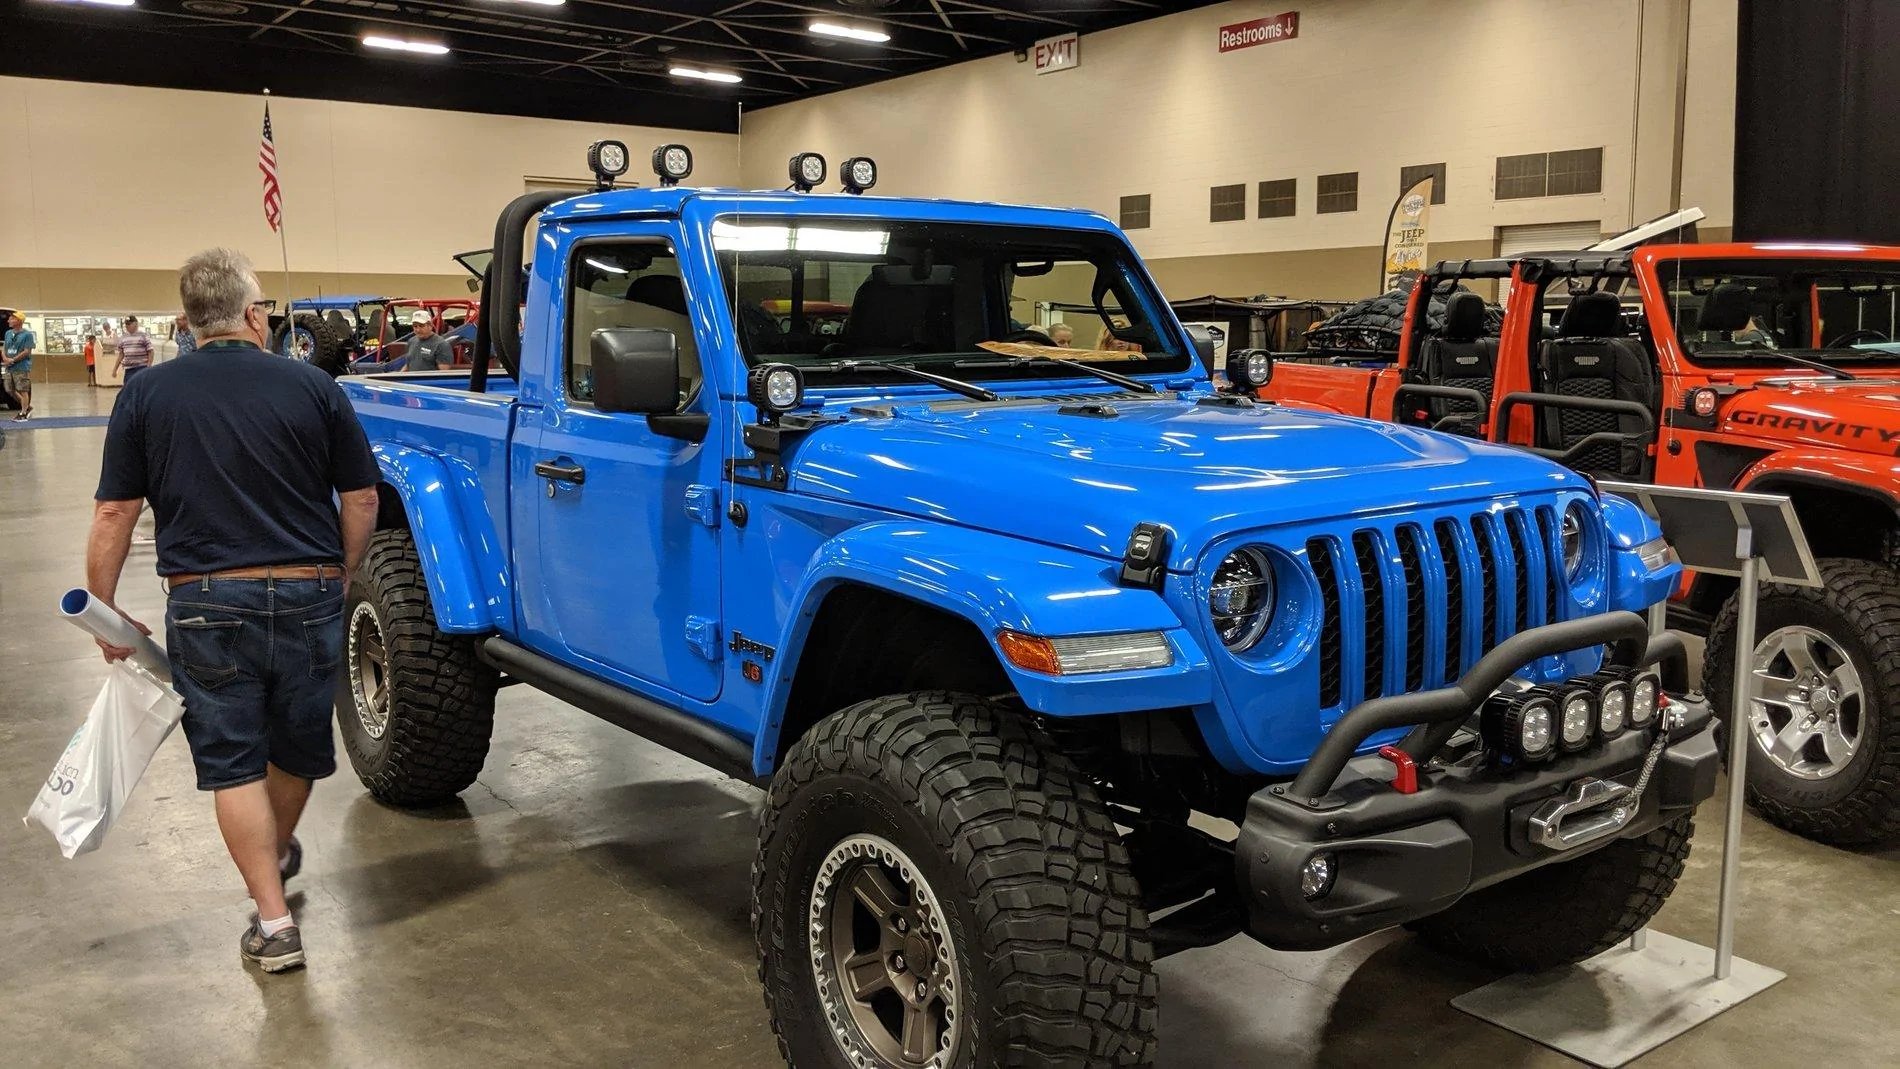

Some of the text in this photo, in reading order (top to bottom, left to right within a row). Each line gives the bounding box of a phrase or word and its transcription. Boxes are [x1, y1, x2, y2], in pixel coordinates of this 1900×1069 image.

[1221, 23, 1282, 48] Restrooms
[1036, 38, 1076, 69] EXIT
[1400, 228, 1425, 243] JEEP
[1731, 410, 1900, 443] GRAVITY
[728, 629, 776, 662] Jeep
